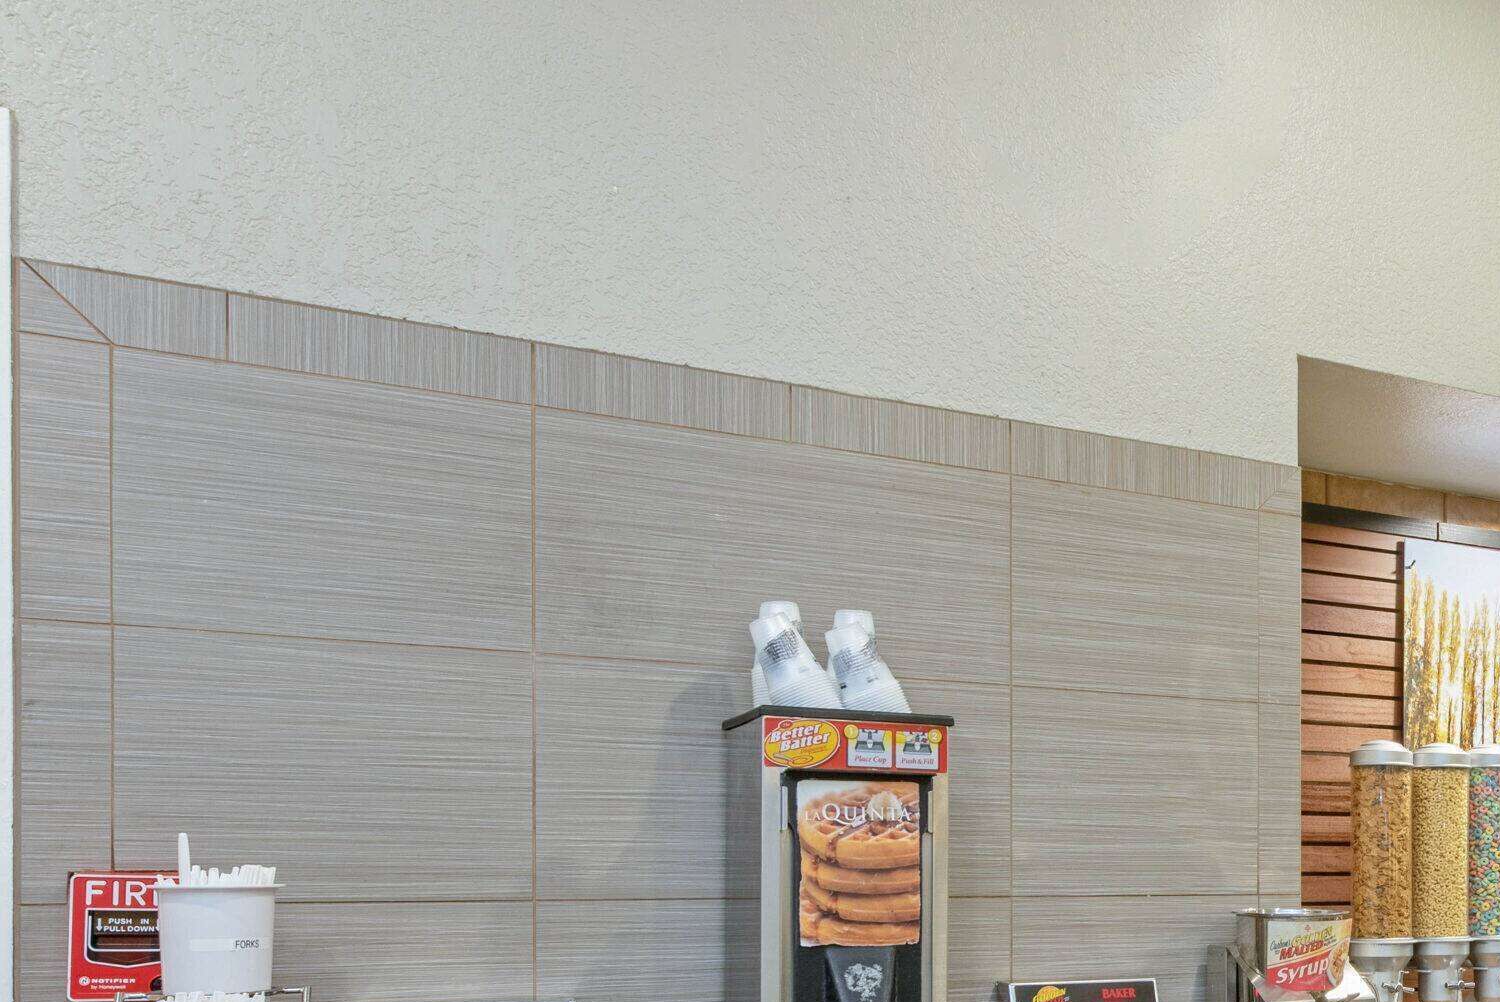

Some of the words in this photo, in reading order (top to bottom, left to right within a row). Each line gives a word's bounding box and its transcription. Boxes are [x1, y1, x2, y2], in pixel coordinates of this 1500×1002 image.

[770, 725, 821, 743] Better
[780, 733, 830, 752] Batter
[85, 880, 159, 906] FIR
[108, 917, 132, 925] PUSH
[140, 917, 150, 925] IN
[234, 939, 260, 949] FORKS
[1276, 957, 1329, 985] Syrup
[1102, 987, 1137, 999] BAKER
